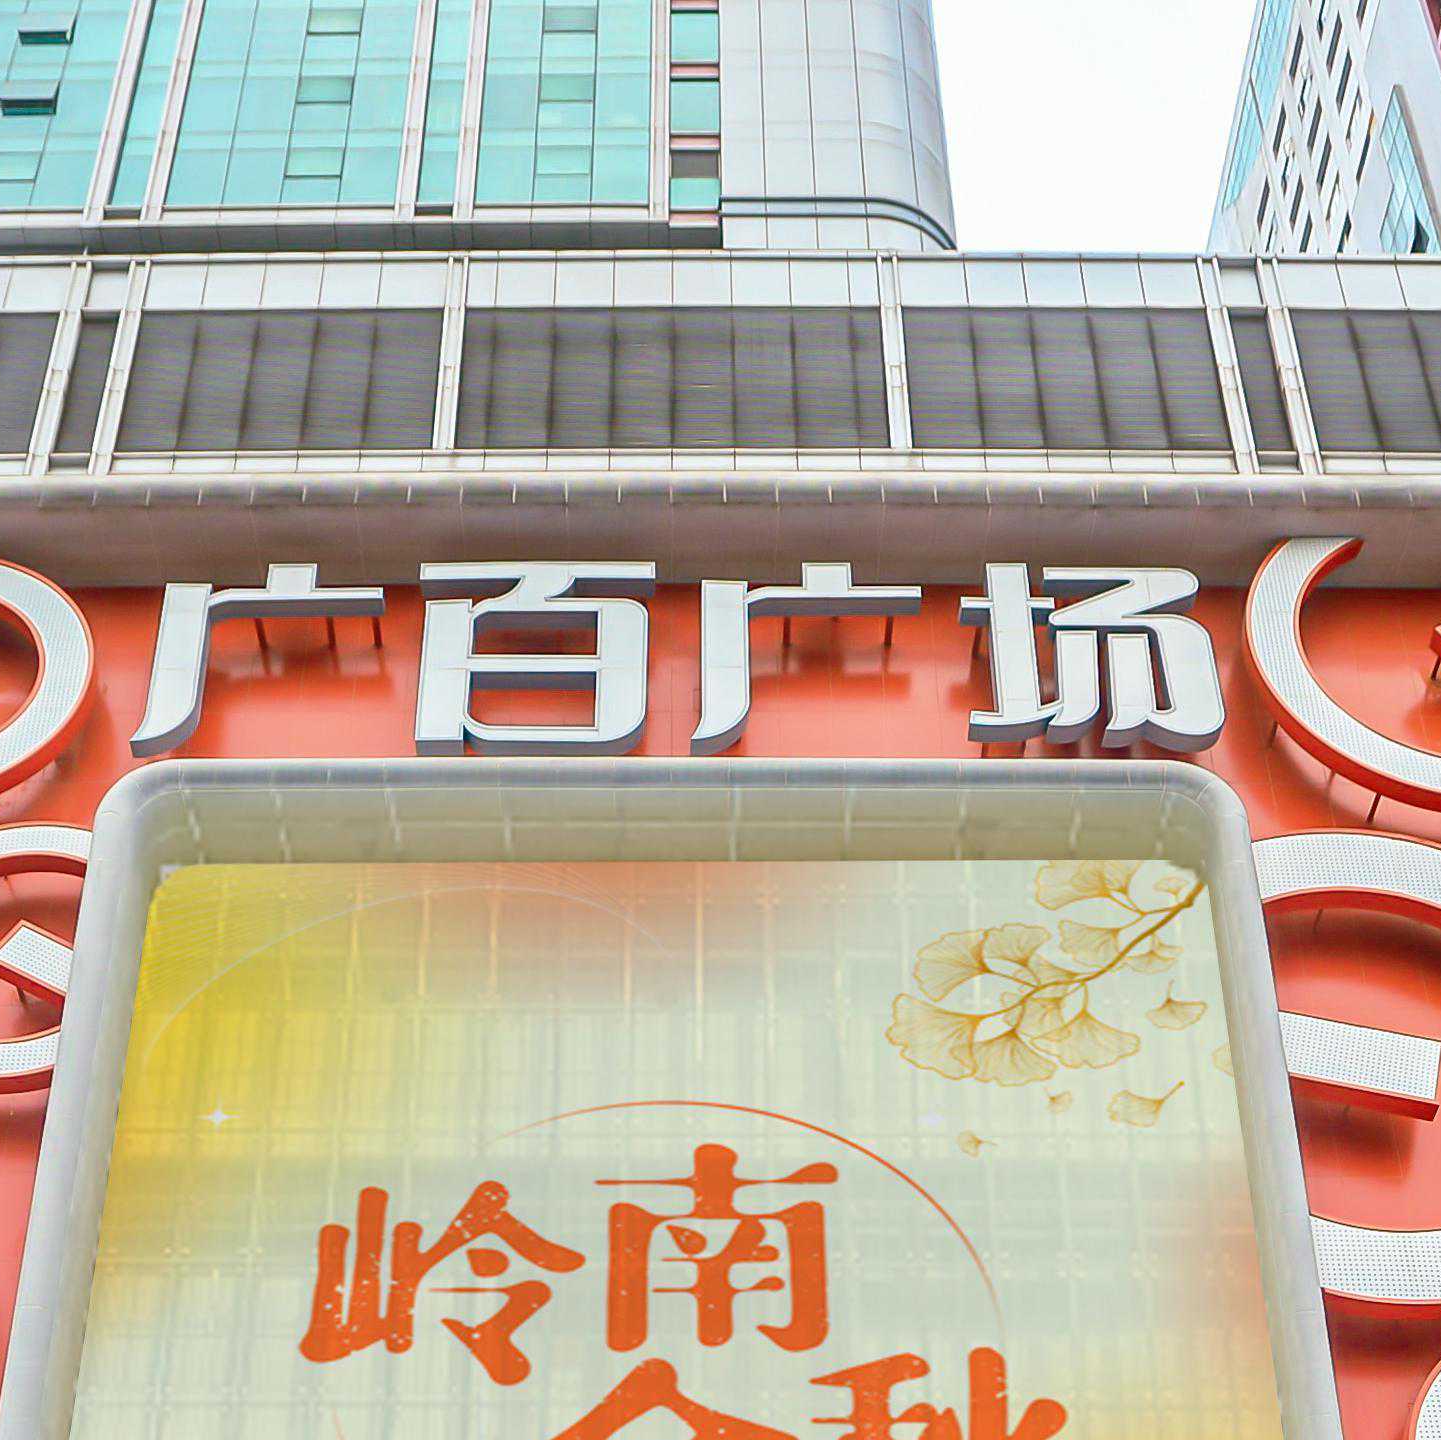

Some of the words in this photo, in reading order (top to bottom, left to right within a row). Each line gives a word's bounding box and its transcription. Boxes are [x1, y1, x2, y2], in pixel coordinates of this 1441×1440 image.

[130, 562, 1226, 757] 广百广场
[300, 1142, 839, 1386] 岭南
